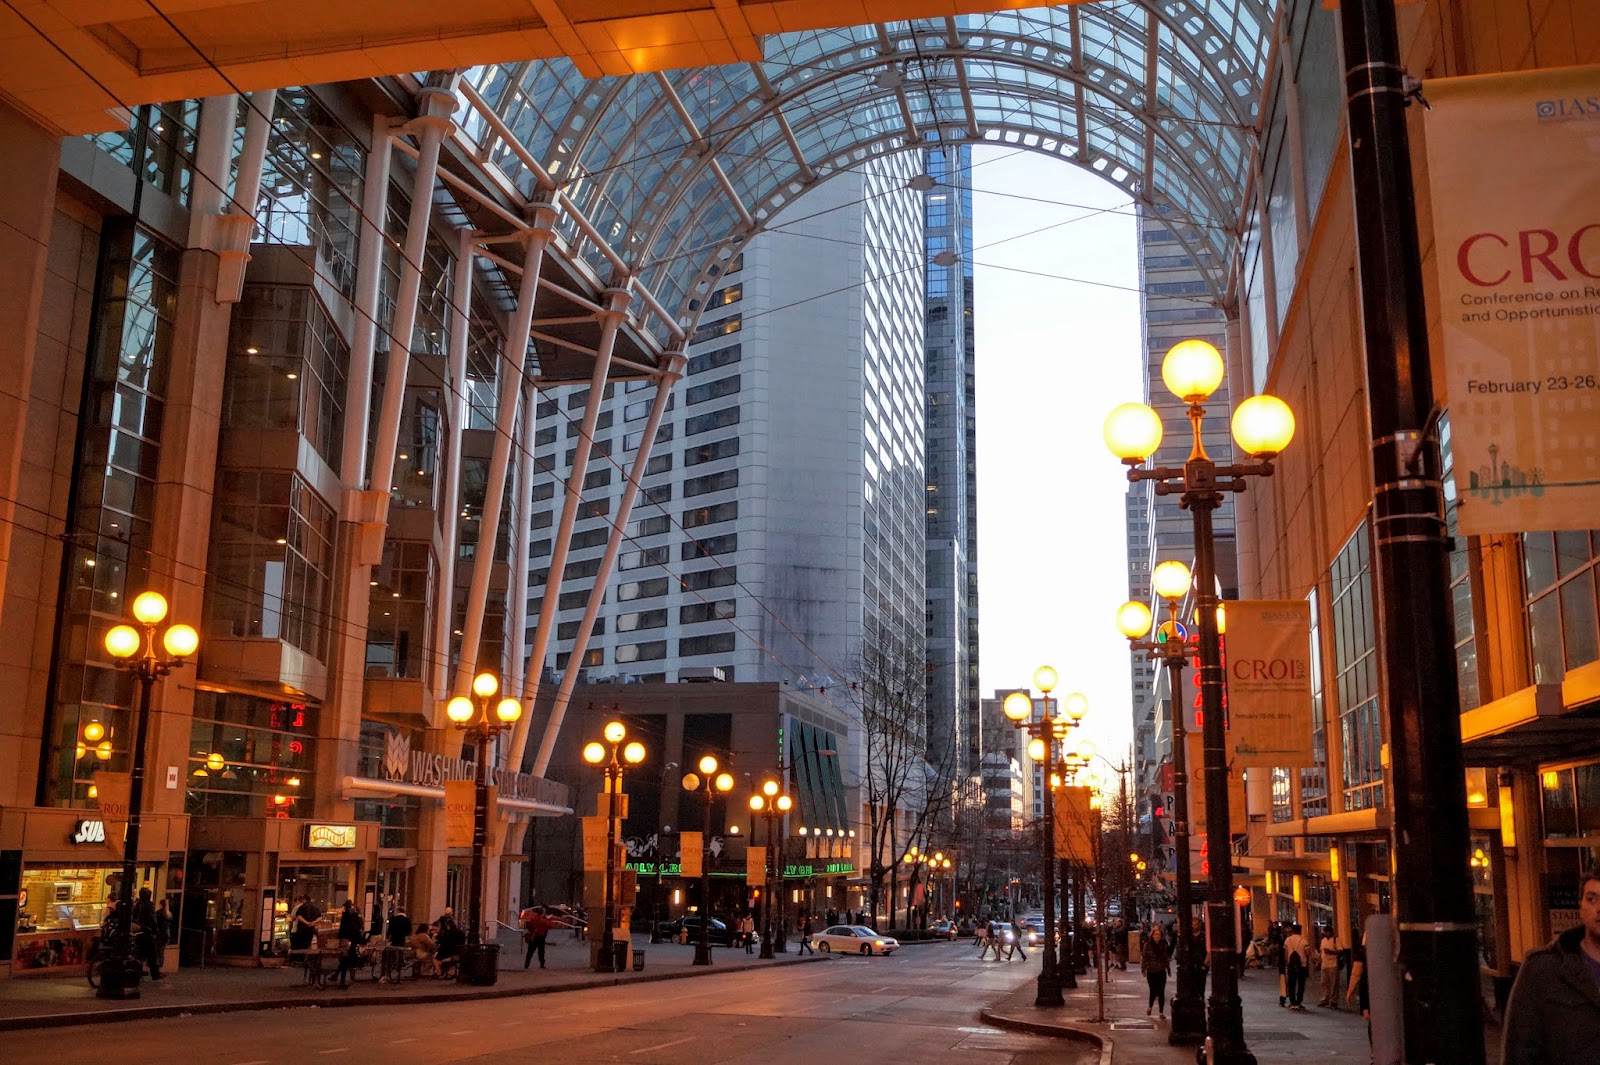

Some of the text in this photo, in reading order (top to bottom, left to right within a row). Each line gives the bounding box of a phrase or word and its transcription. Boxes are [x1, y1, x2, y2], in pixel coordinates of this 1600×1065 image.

[1460, 292, 1554, 306] Conference
[1560, 289, 1579, 300] on
[1462, 310, 1490, 322] and
[1467, 380, 1541, 395] February
[1233, 659, 1295, 681] CROI
